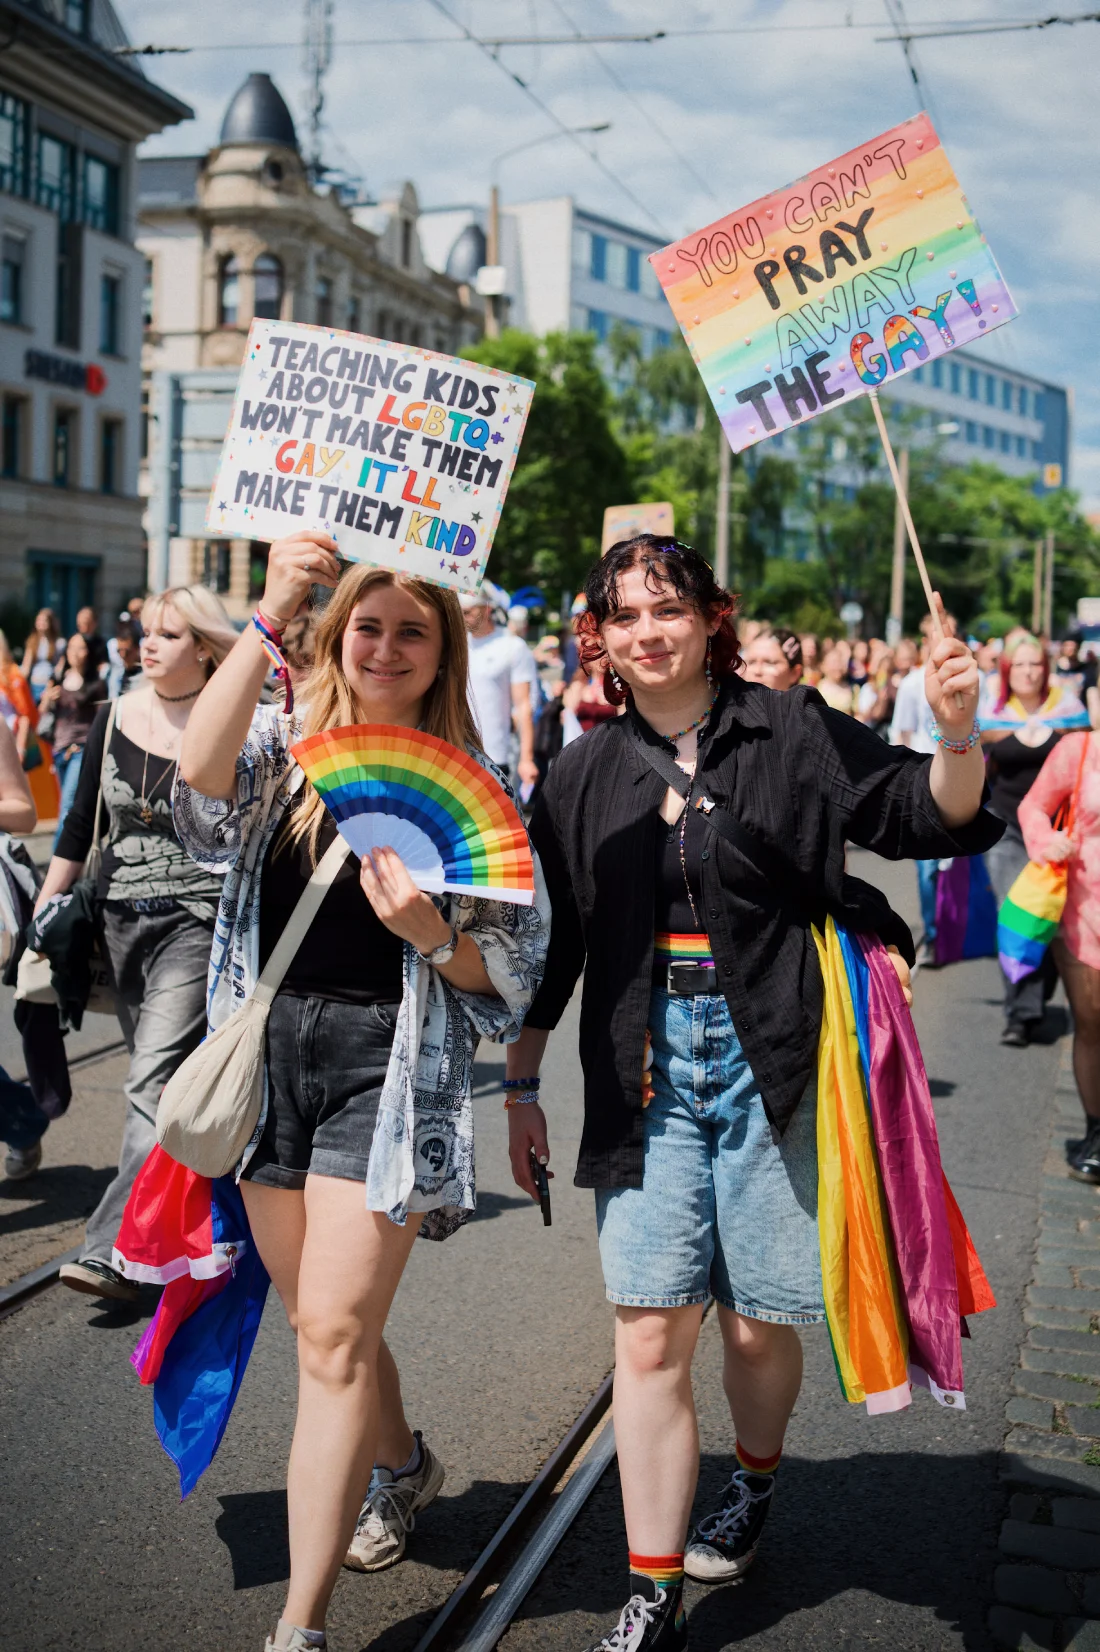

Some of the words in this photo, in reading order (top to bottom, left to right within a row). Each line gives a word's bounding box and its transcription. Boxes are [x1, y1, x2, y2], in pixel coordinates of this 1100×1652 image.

[676, 216, 766, 287] YOU
[784, 138, 907, 234] CAN'T
[753, 206, 875, 310] PRAY
[776, 247, 917, 369] AWAY
[269, 337, 418, 394] TEACHING
[423, 367, 500, 417] KIDS
[735, 351, 845, 432] THE
[850, 279, 987, 386] GAY!
[240, 400, 324, 439] WON'T
[326, 413, 414, 462] MAKE
[421, 438, 504, 489] THEM
[265, 371, 376, 415] ABOUT
[377, 394, 505, 451] LGBTQ+
[233, 470, 312, 516] MAKE
[318, 484, 404, 539] THEM
[405, 511, 477, 557] KIND
[275, 440, 345, 478] GAY
[357, 457, 442, 511] IT'LL
